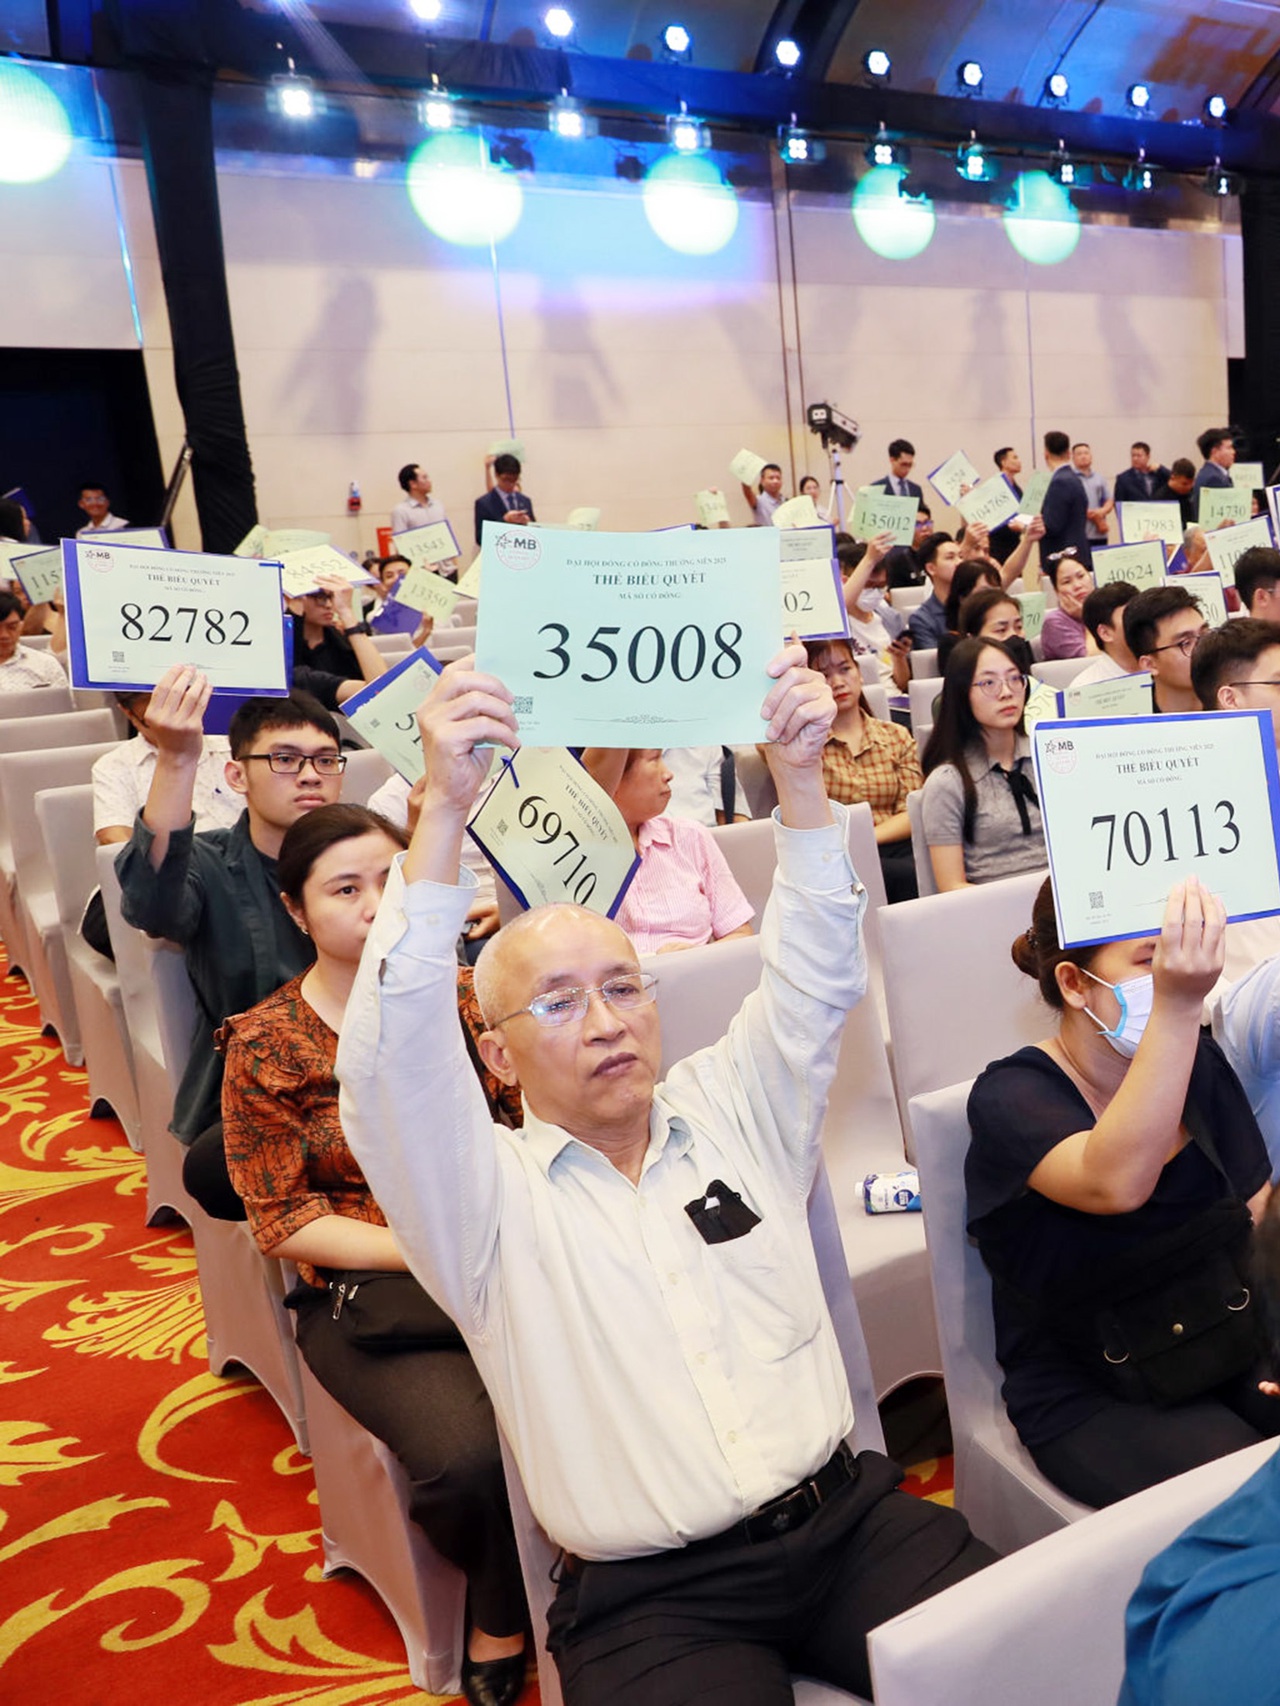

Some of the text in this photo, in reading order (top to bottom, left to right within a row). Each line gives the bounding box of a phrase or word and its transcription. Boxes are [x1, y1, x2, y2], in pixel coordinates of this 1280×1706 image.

[1210, 504, 1246, 518] 14730
[861, 512, 910, 531] 135012
[1136, 519, 1175, 531] 17983
[514, 538, 536, 550] MB
[1107, 563, 1153, 581] 40624
[120, 603, 253, 646] 82782
[533, 622, 743, 684] 35008
[1058, 740, 1074, 751] MB
[1090, 800, 1240, 871] 70113
[518, 795, 597, 906] 69710
